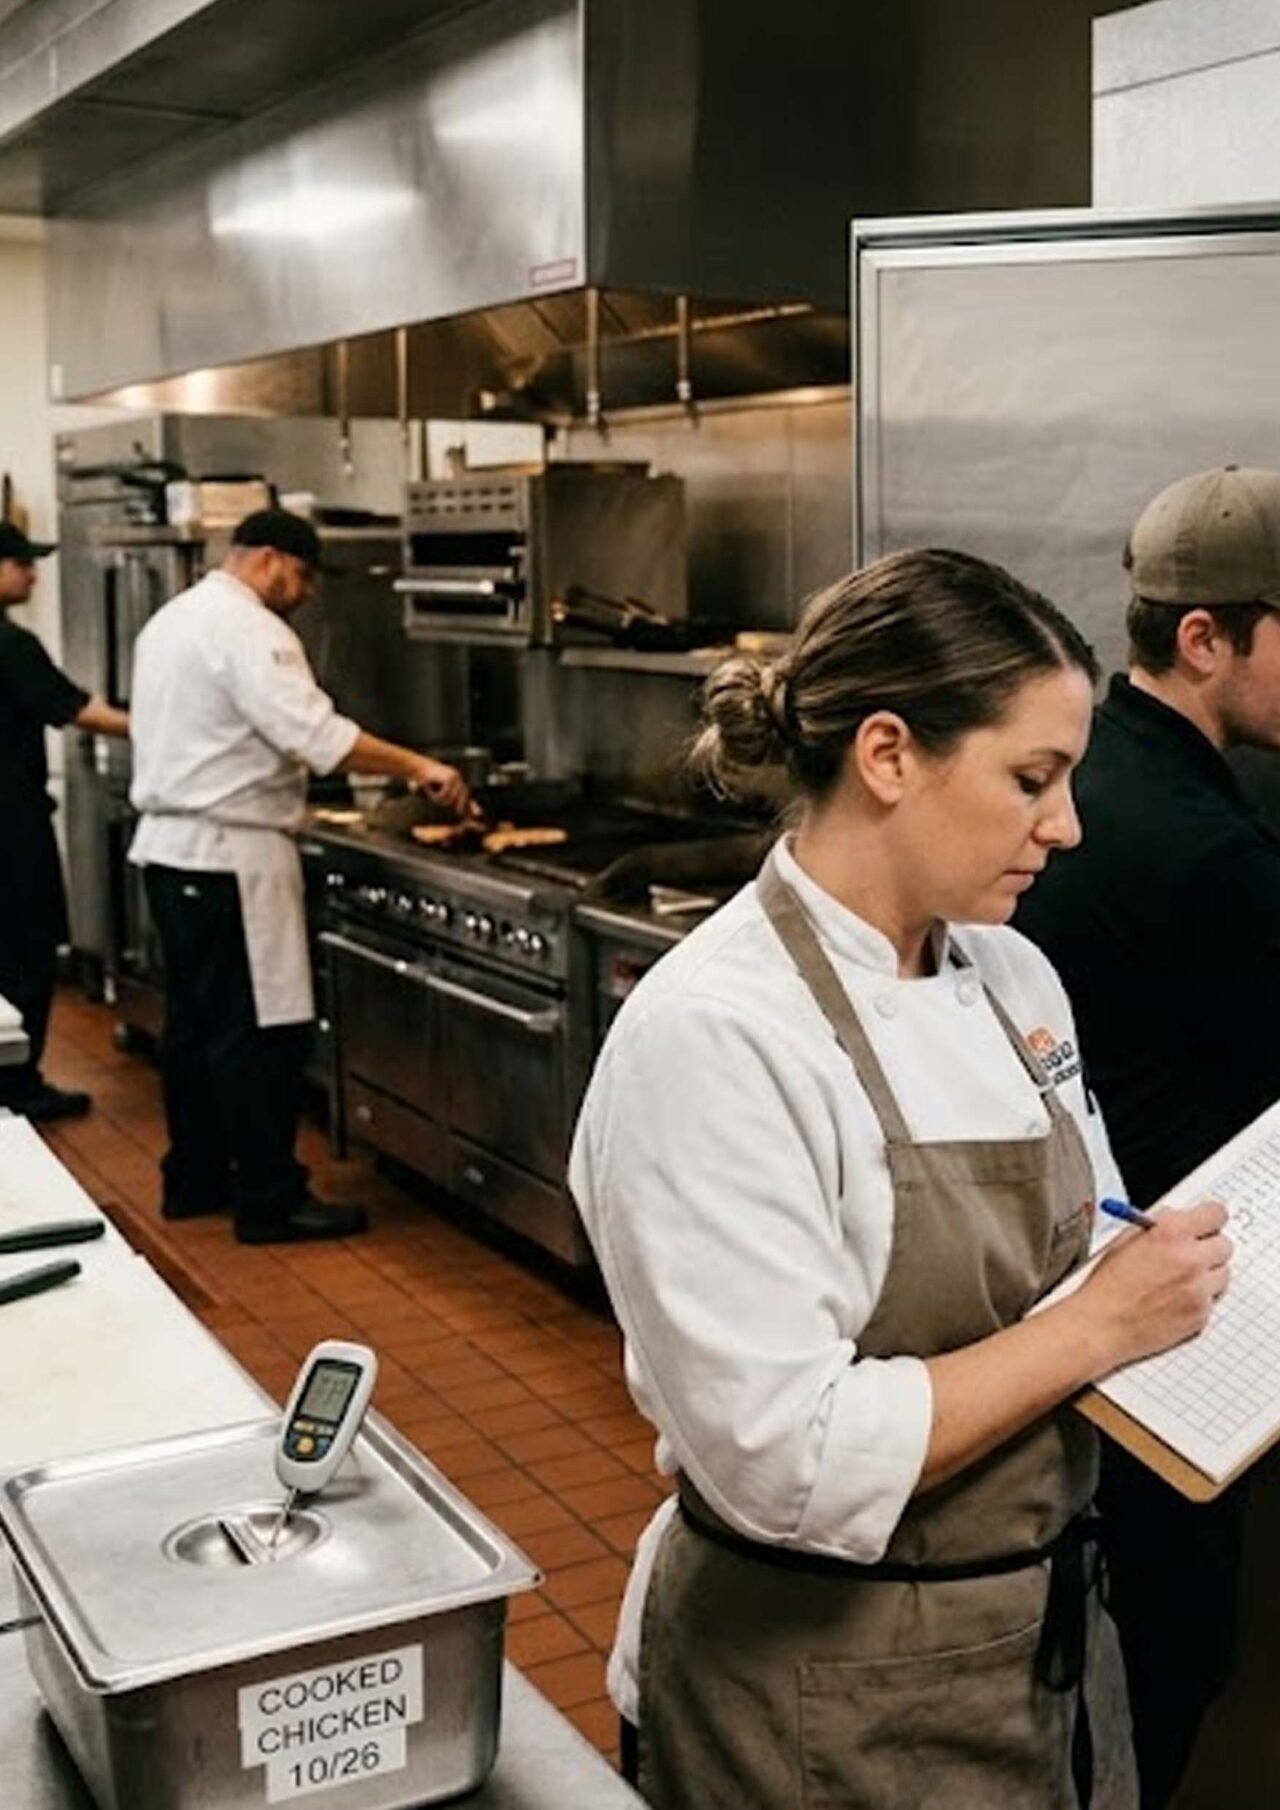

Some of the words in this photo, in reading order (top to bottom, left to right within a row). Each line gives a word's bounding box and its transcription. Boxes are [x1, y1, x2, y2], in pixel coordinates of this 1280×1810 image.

[258, 1658, 403, 1715] COOKED
[257, 1694, 406, 1754] CHICKEN
[289, 1741, 380, 1787] 10/26
